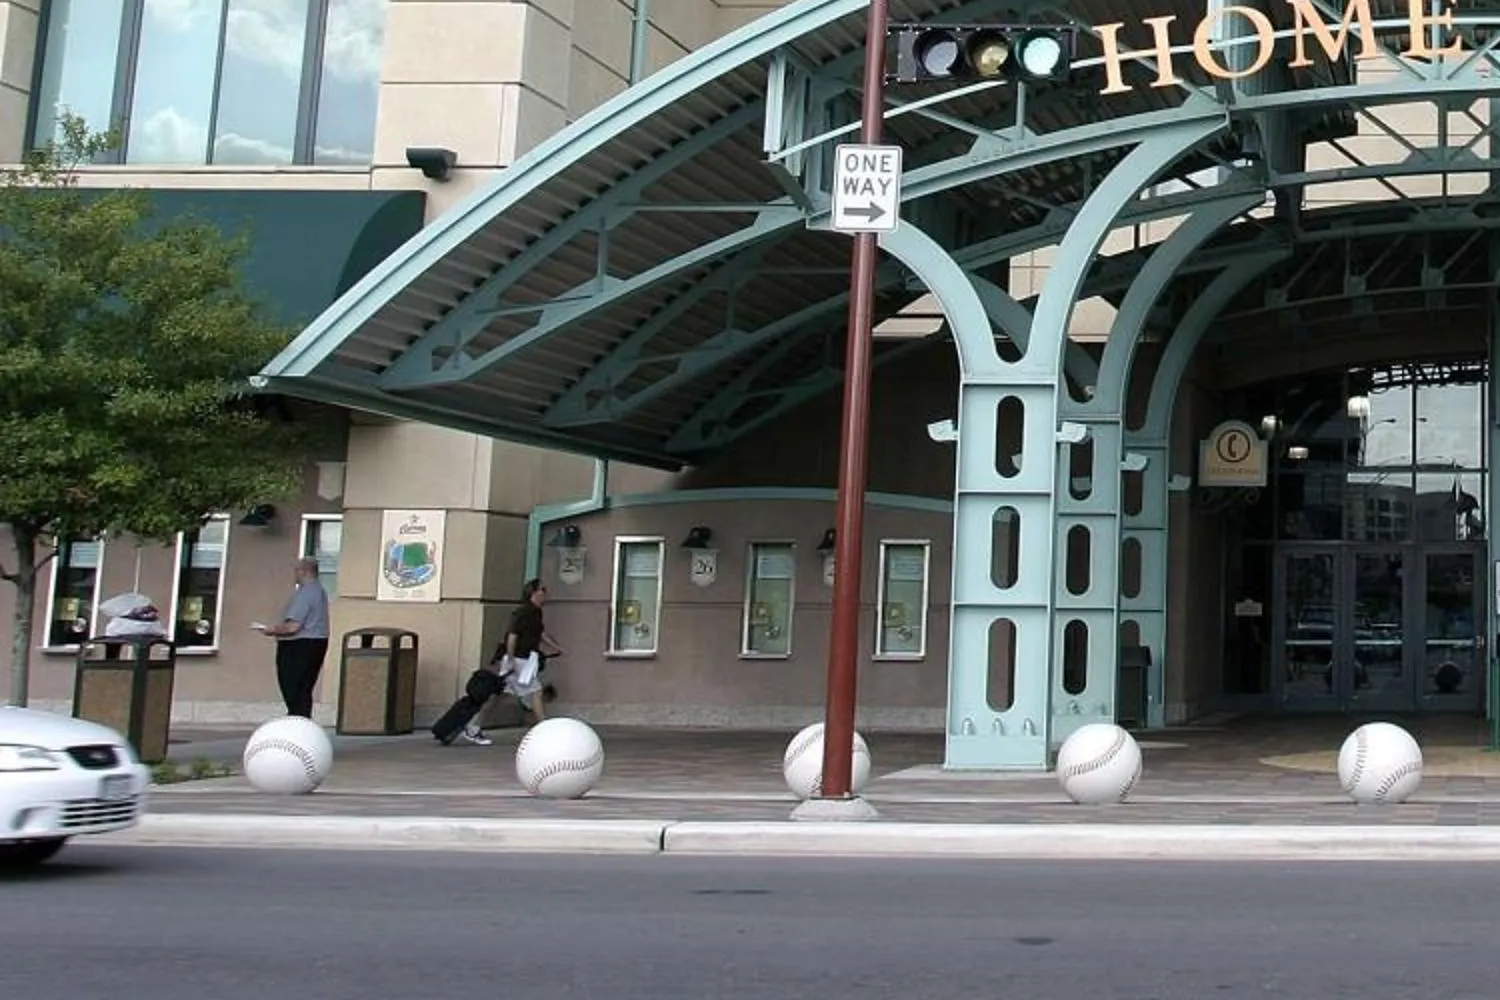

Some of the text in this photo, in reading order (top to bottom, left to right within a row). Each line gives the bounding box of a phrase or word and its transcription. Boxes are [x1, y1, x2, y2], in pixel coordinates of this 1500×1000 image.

[845, 153, 892, 173] ONE
[843, 177, 892, 196] WAY
[695, 558, 713, 575] 26
